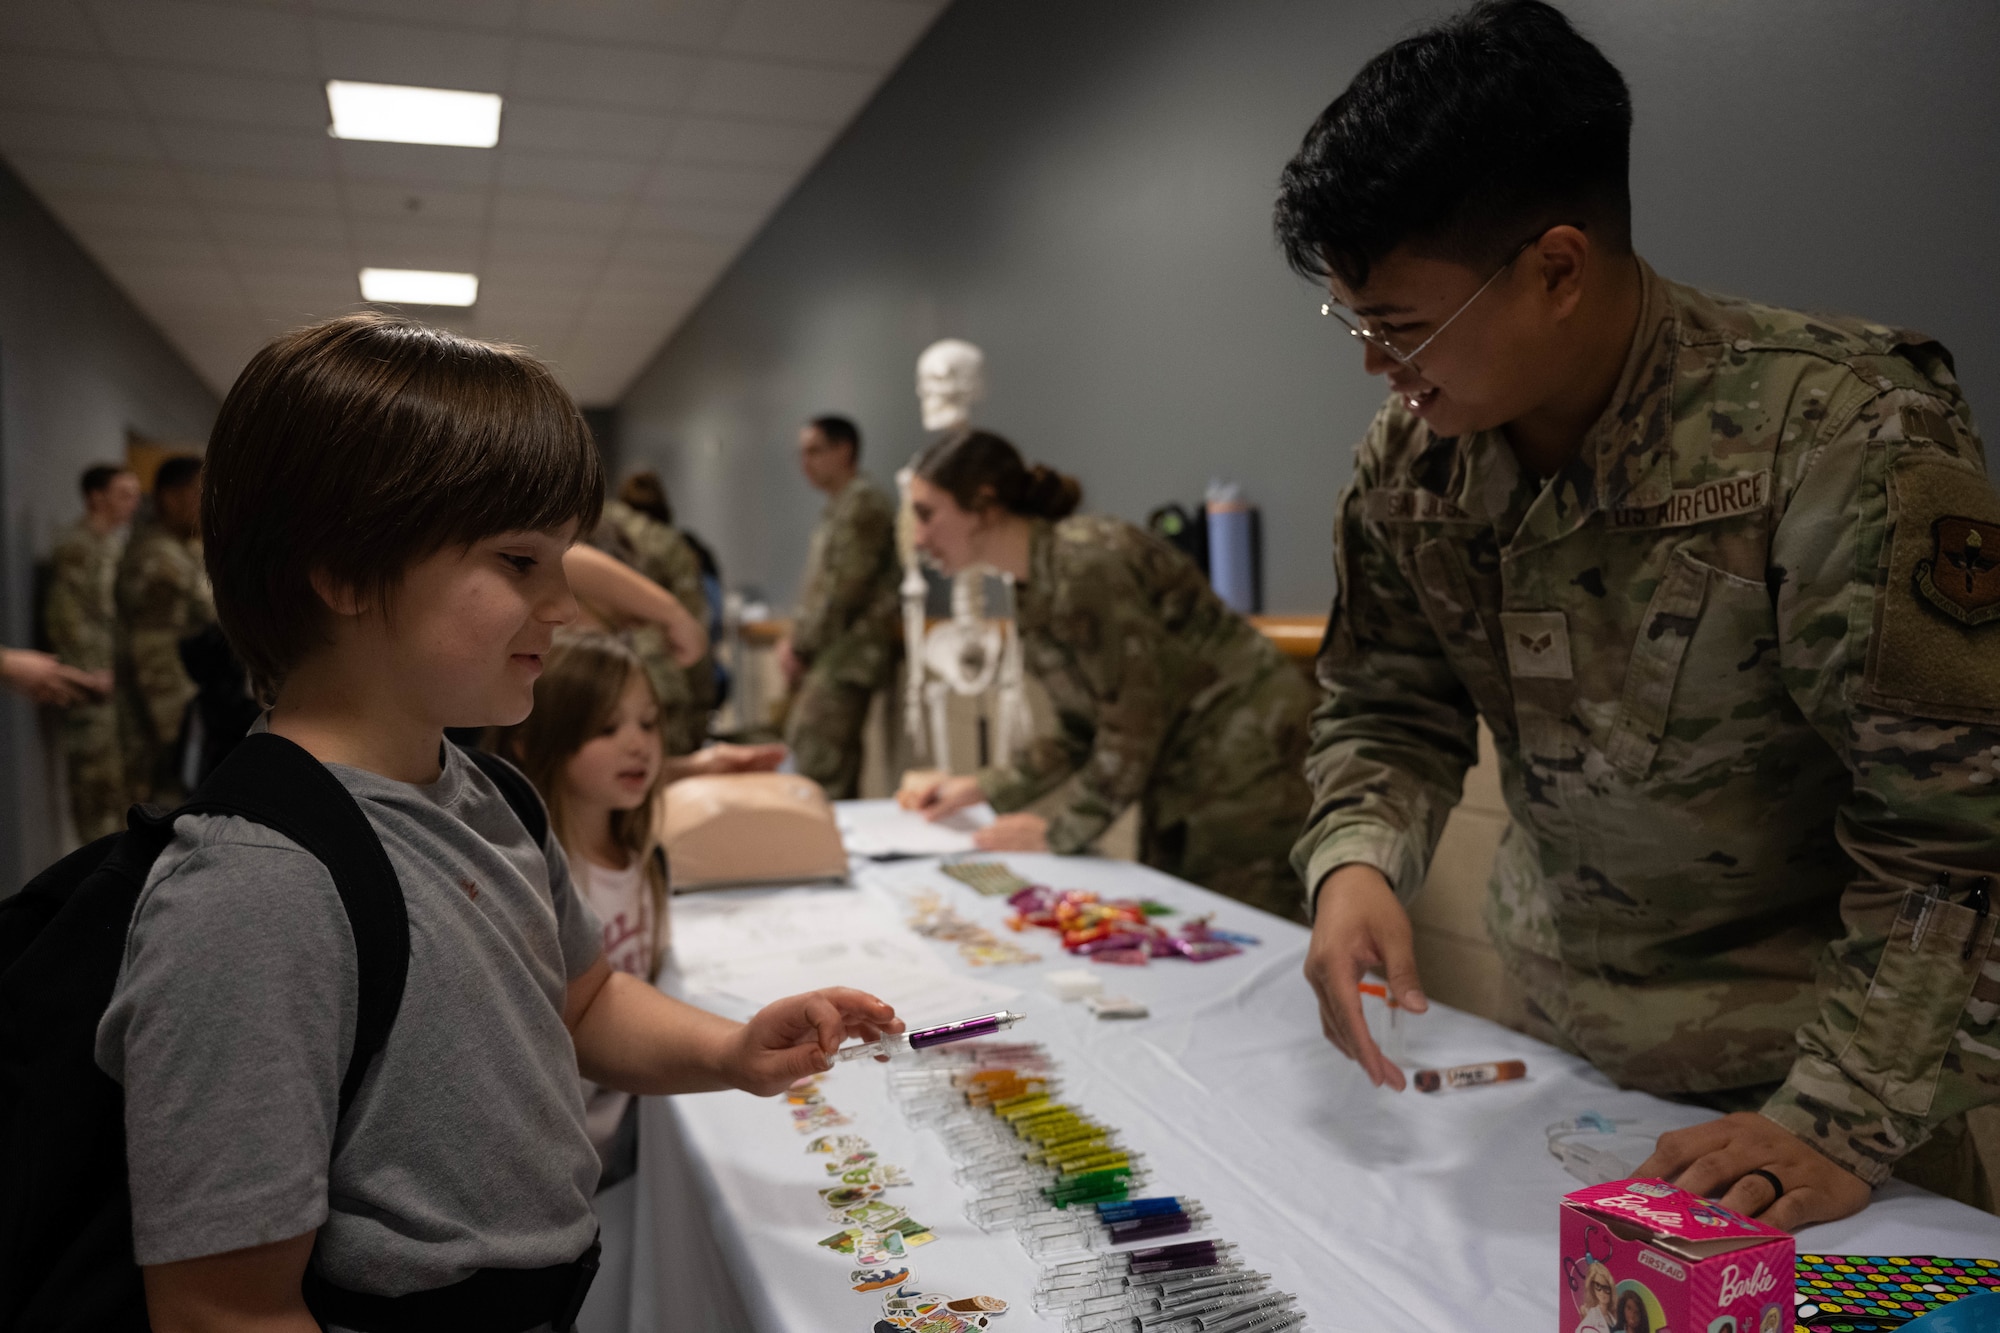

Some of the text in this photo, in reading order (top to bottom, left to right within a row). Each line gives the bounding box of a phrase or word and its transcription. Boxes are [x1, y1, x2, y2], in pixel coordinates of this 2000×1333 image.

[1593, 1193, 1684, 1228] Barbie
[1640, 1253, 1684, 1279] FIRST AID
[1717, 1261, 1778, 1307] Barbie
